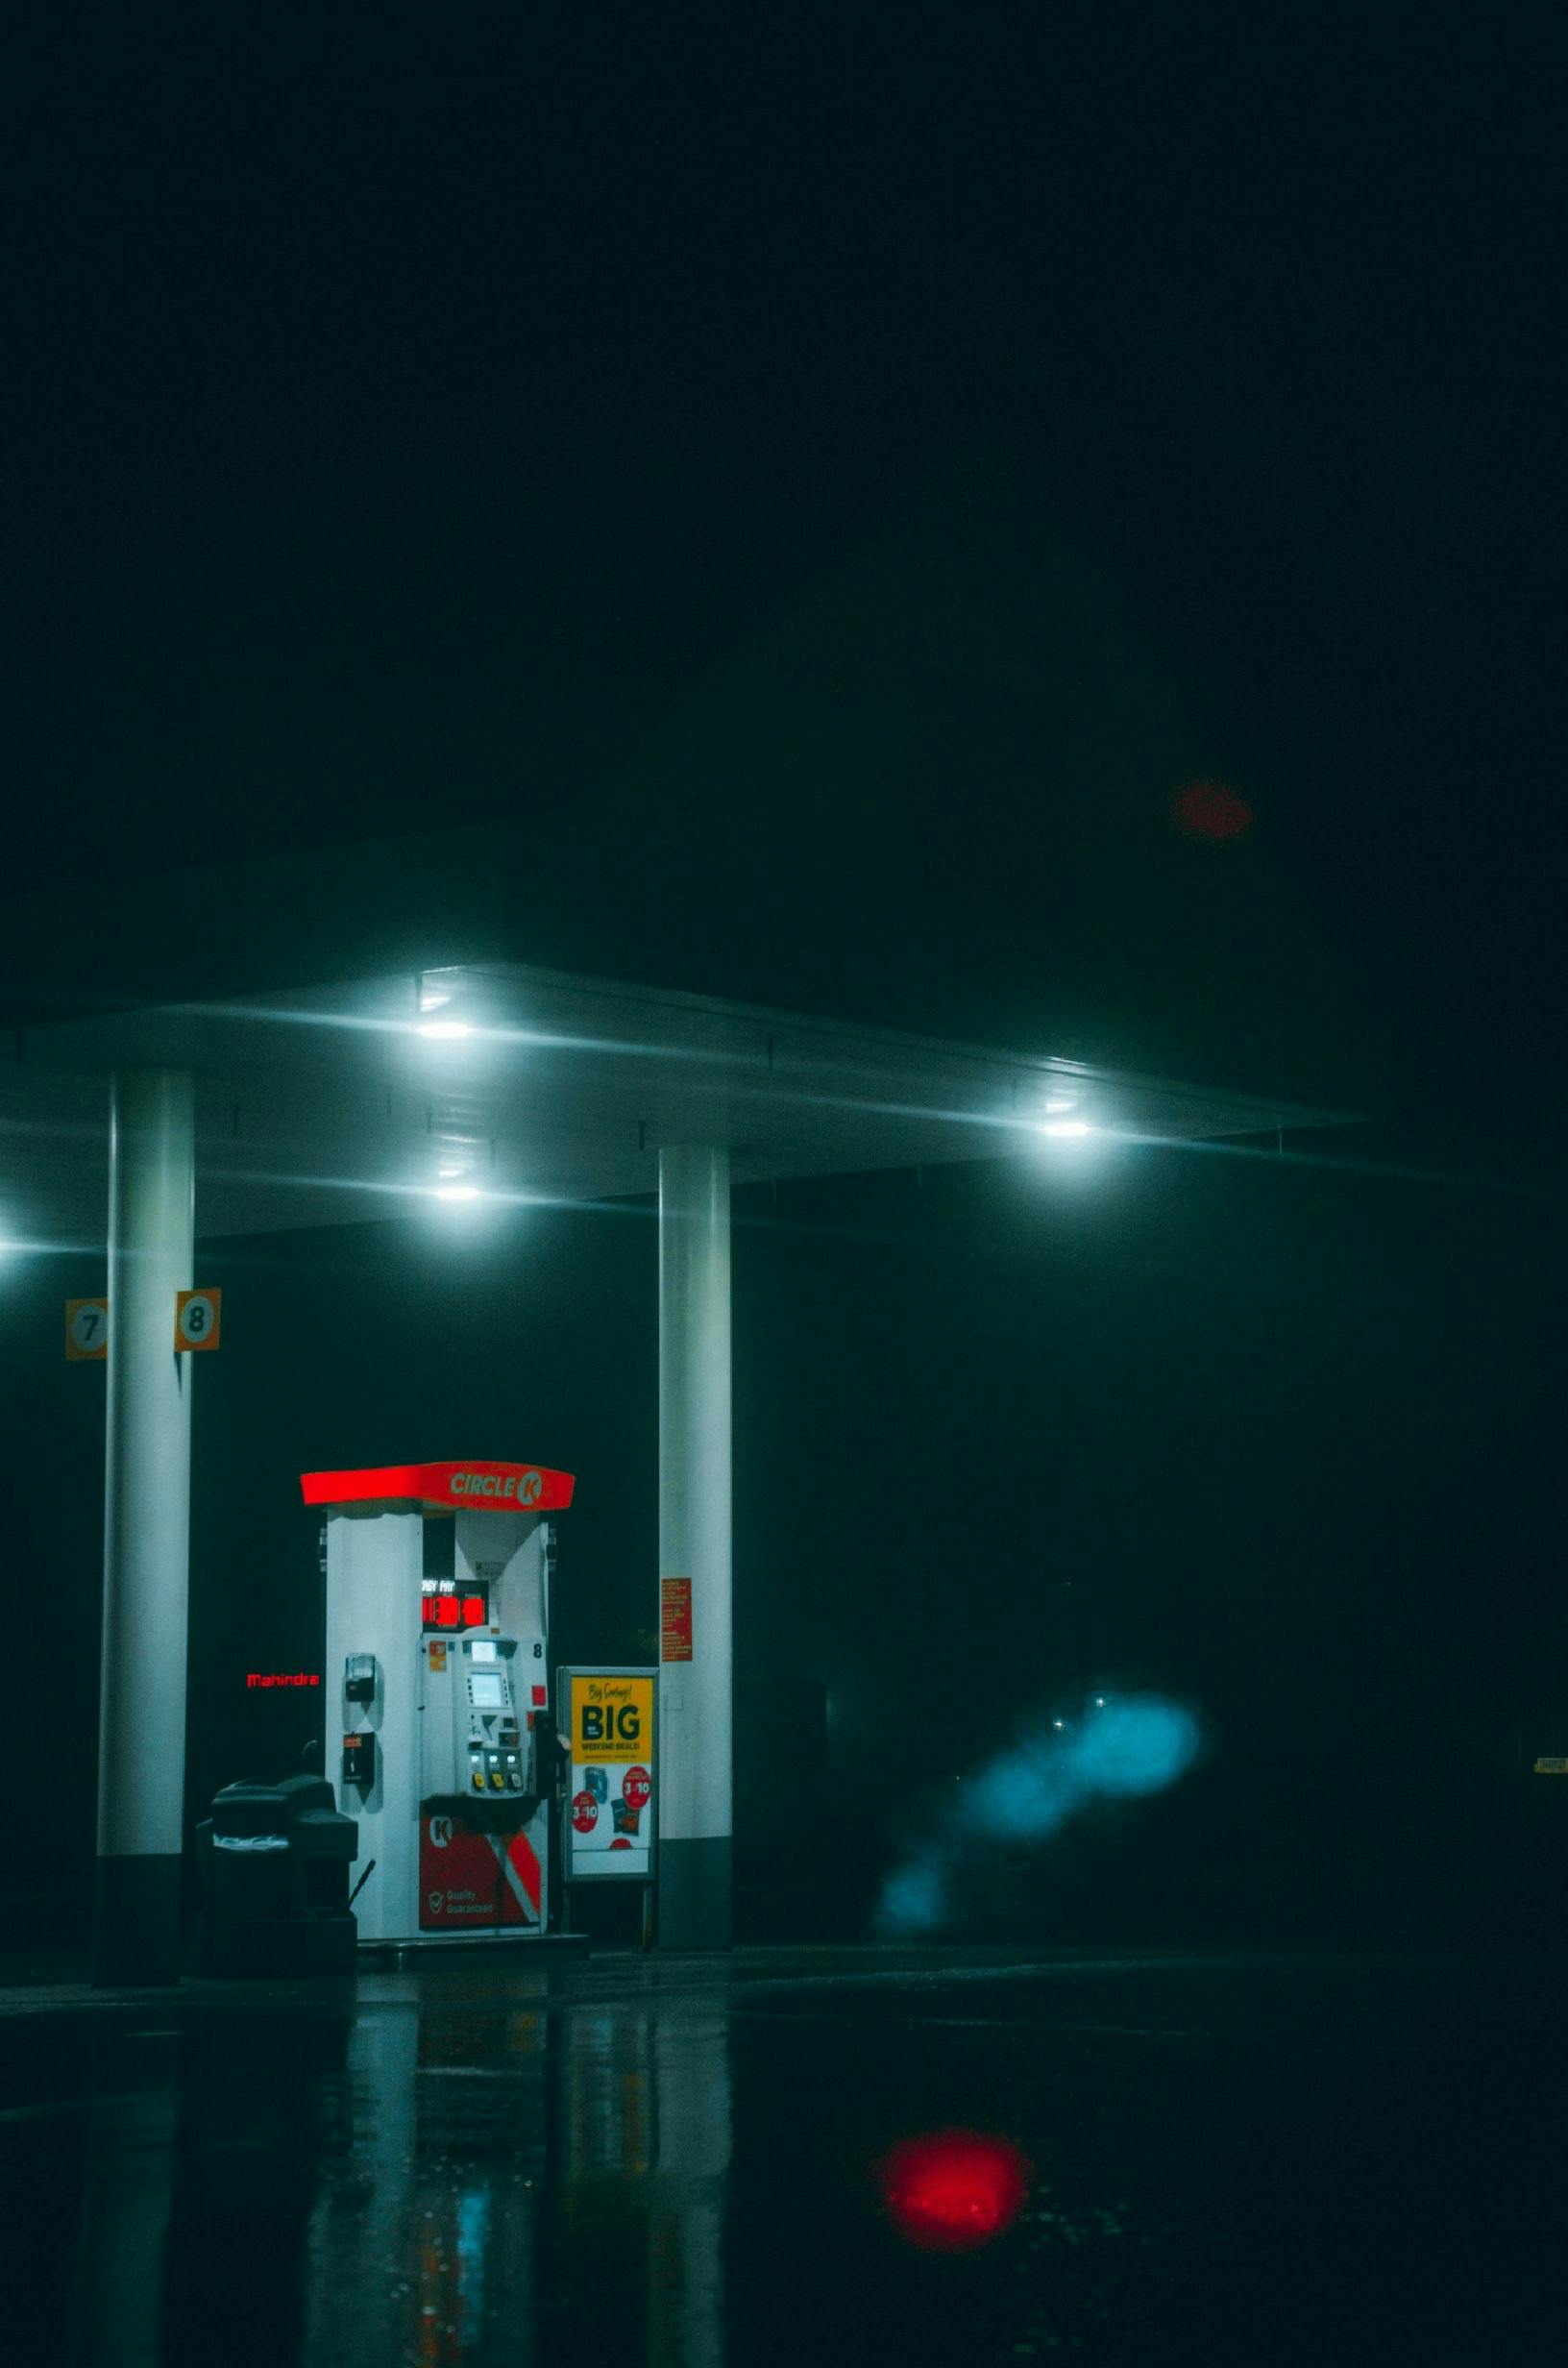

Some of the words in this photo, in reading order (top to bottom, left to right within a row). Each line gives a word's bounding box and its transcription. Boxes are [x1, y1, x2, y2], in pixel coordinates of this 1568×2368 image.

[83, 1315, 99, 1341] 7
[189, 1306, 205, 1332] 8
[451, 1472, 516, 1497] CIRCLE
[517, 1470, 542, 1506] K
[533, 1643, 542, 1659] 8
[582, 1705, 640, 1740] BIG
[625, 1783, 631, 1794] 3
[574, 1807, 579, 1818] 3
[429, 1816, 452, 1848] K
[447, 1890, 476, 1901] Quality
